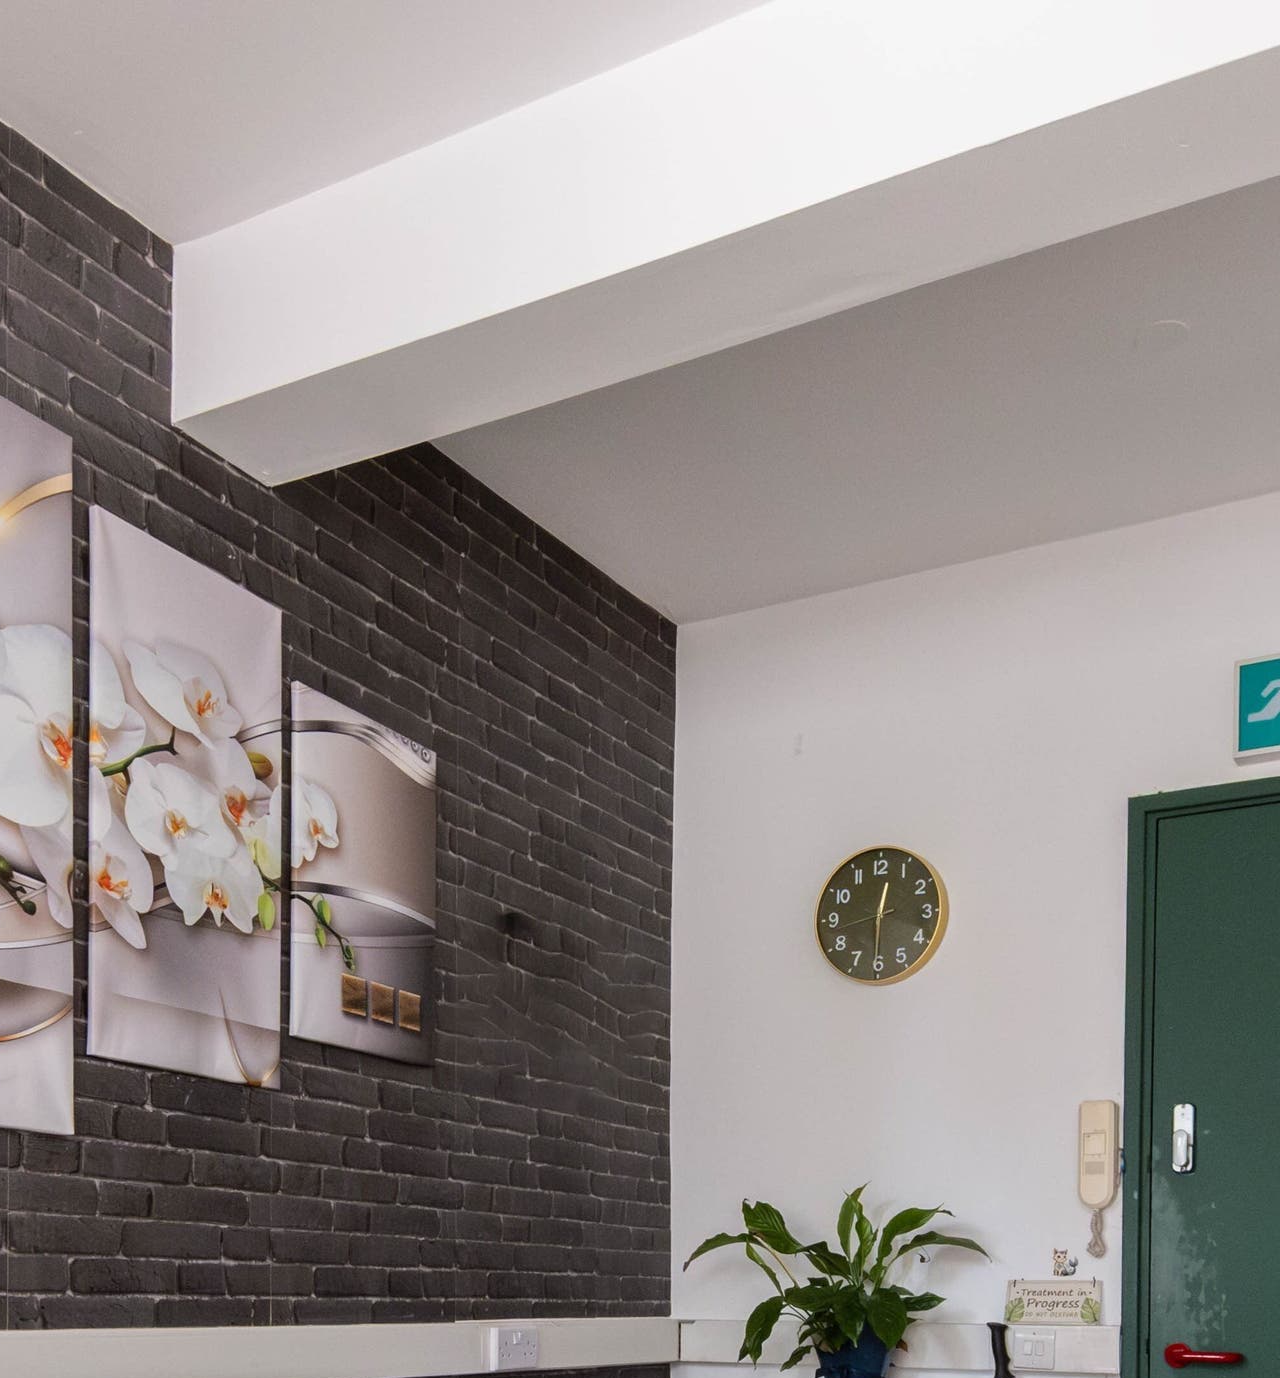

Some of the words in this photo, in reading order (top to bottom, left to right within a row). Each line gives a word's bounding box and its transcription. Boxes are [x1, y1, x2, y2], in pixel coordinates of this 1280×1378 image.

[873, 859, 889, 876] 12
[901, 863, 906, 878] 1
[854, 868, 863, 885] 11
[914, 879, 927, 895] 2
[836, 889, 851, 904] 10
[921, 903, 932, 919] 3
[828, 912, 839, 928] 9
[835, 935, 846, 951] 8
[913, 928, 925, 944] 4
[851, 950, 862, 966] 7
[873, 955, 884, 971] 6
[895, 947, 907, 963] 5
[1021, 1288, 1073, 1297] Treatment
[1077, 1288, 1087, 1297] in
[1026, 1298, 1080, 1311] Progress
